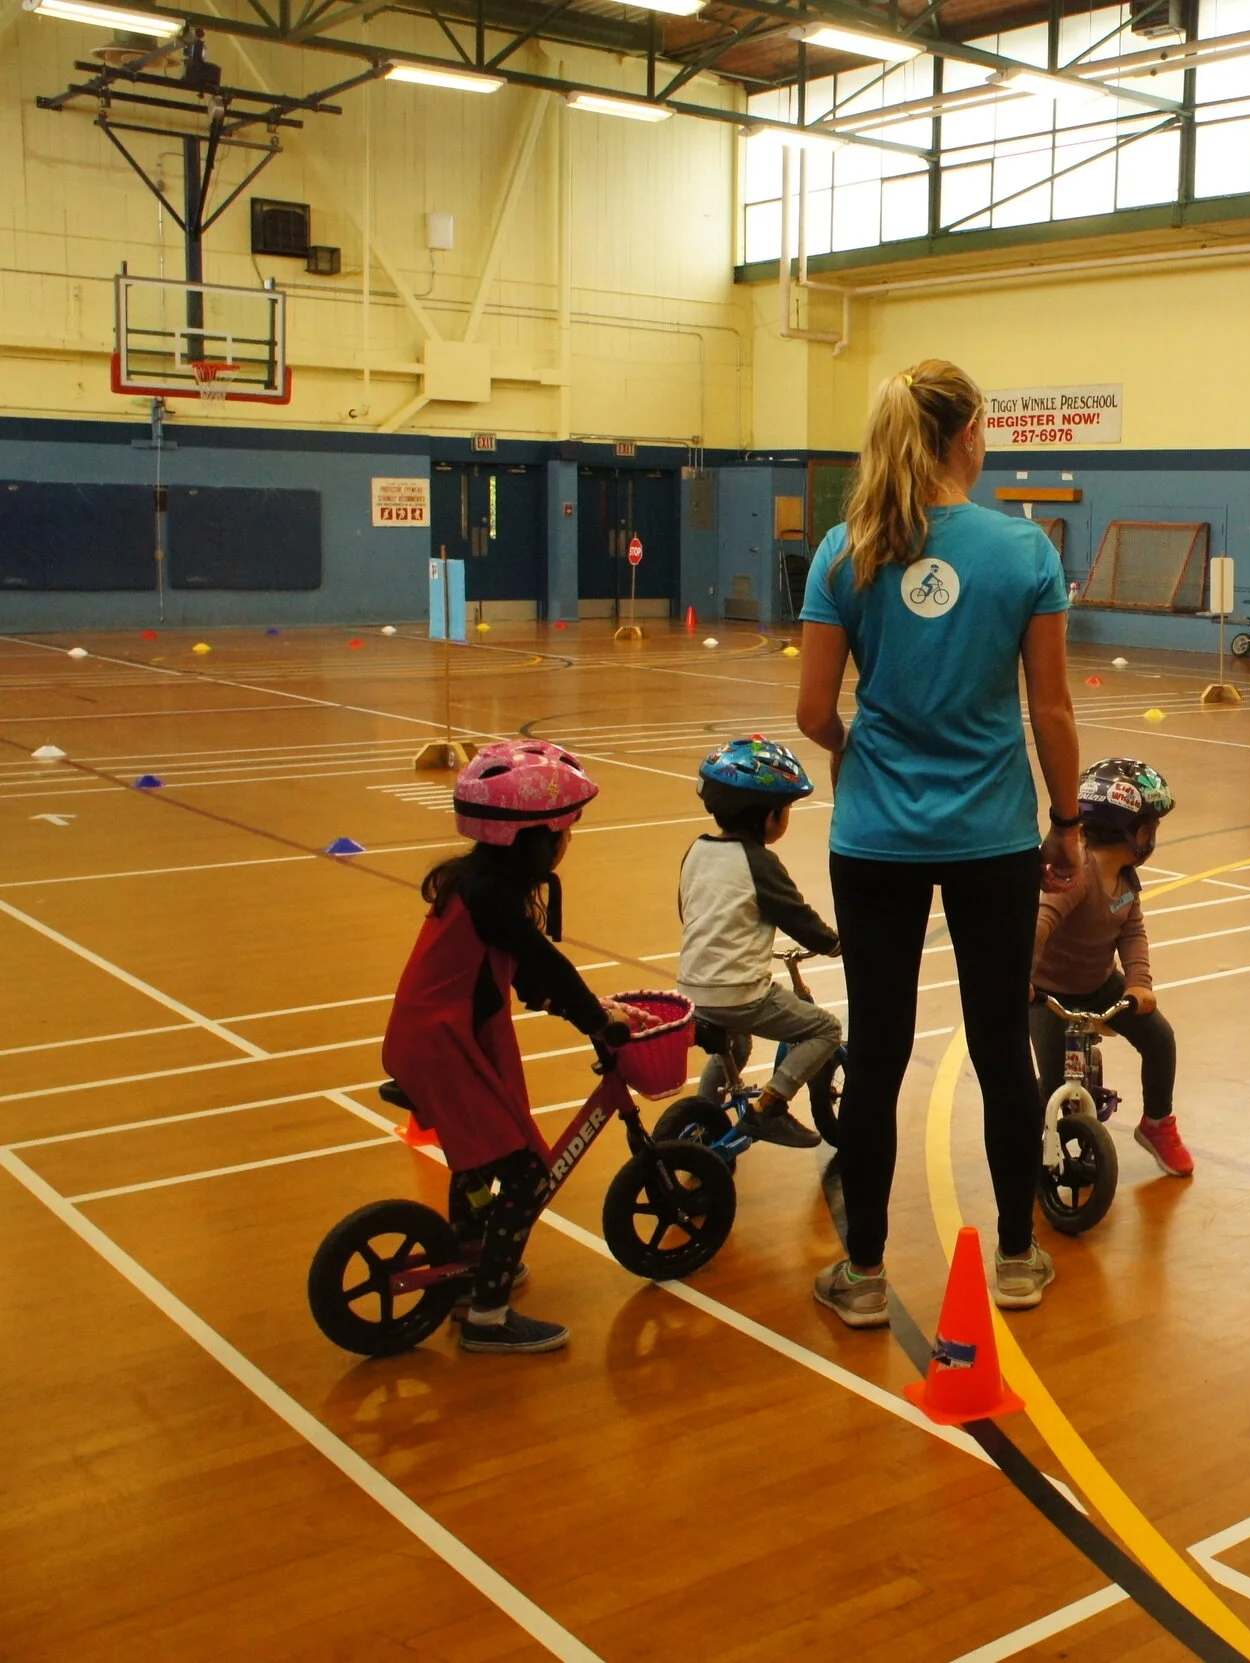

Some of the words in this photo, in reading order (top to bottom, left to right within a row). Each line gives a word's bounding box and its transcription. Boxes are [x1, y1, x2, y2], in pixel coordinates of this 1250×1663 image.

[990, 397, 1018, 414] TIGGY
[1021, 396, 1057, 412] WINKLE
[1060, 393, 1118, 411] PRESCHOOL
[987, 414, 1055, 428] REGISTER
[1062, 412, 1101, 426] NOW!
[477, 436, 494, 450] EXIT
[1012, 428, 1073, 443] 257-6976
[618, 442, 634, 455] EXIT
[629, 546, 641, 557] STOP
[542, 1106, 608, 1203] TRIDER
